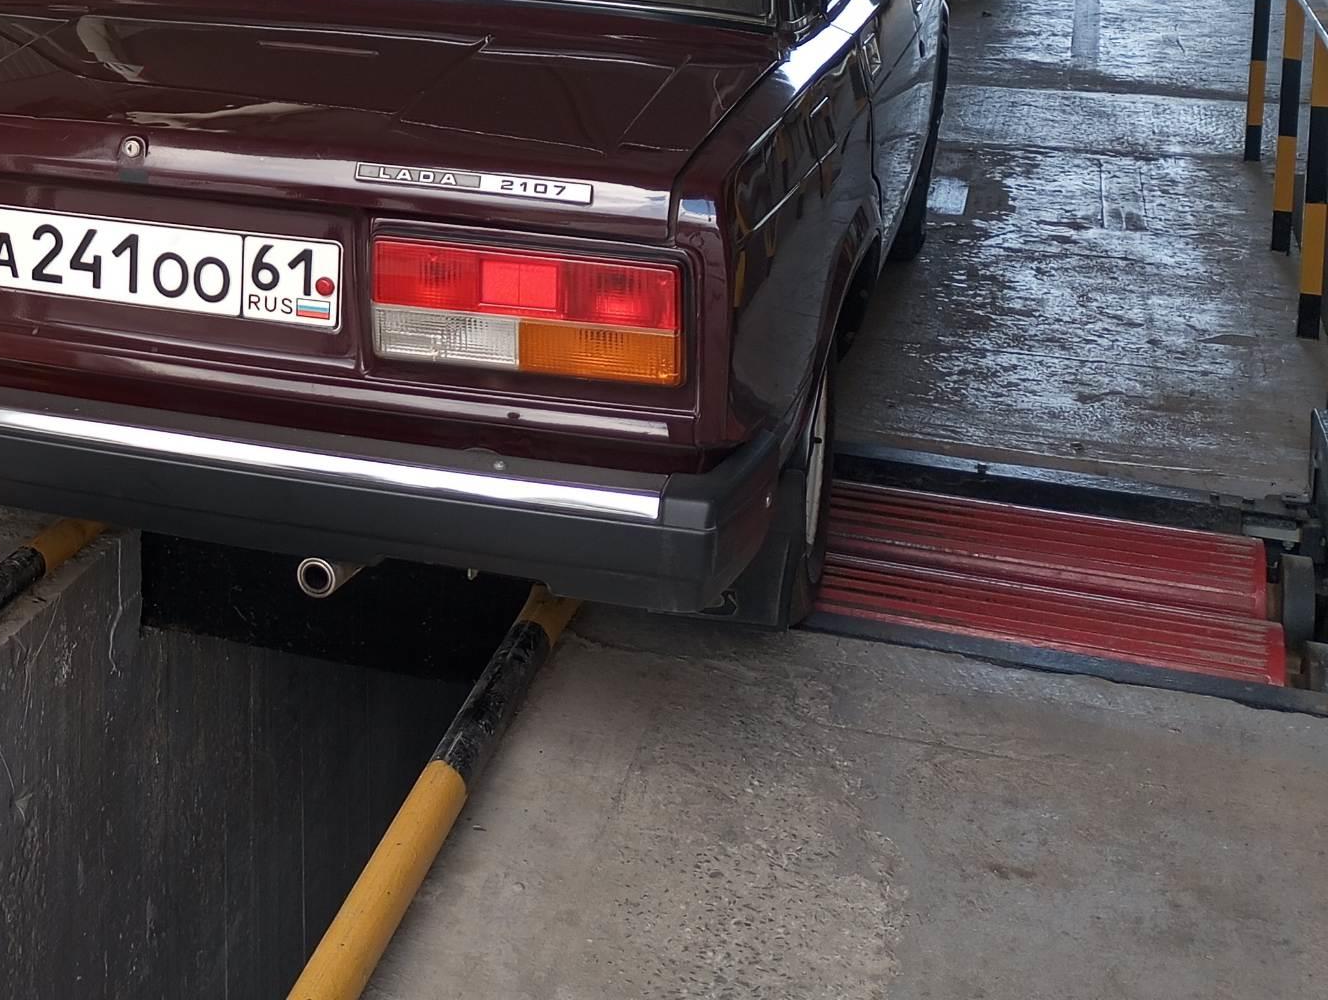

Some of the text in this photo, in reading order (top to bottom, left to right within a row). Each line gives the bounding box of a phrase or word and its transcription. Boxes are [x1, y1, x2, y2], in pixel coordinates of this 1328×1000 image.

[378, 166, 566, 196] LADA 2107
[251, 244, 314, 296] 61
[248, 294, 293, 315] RUS
